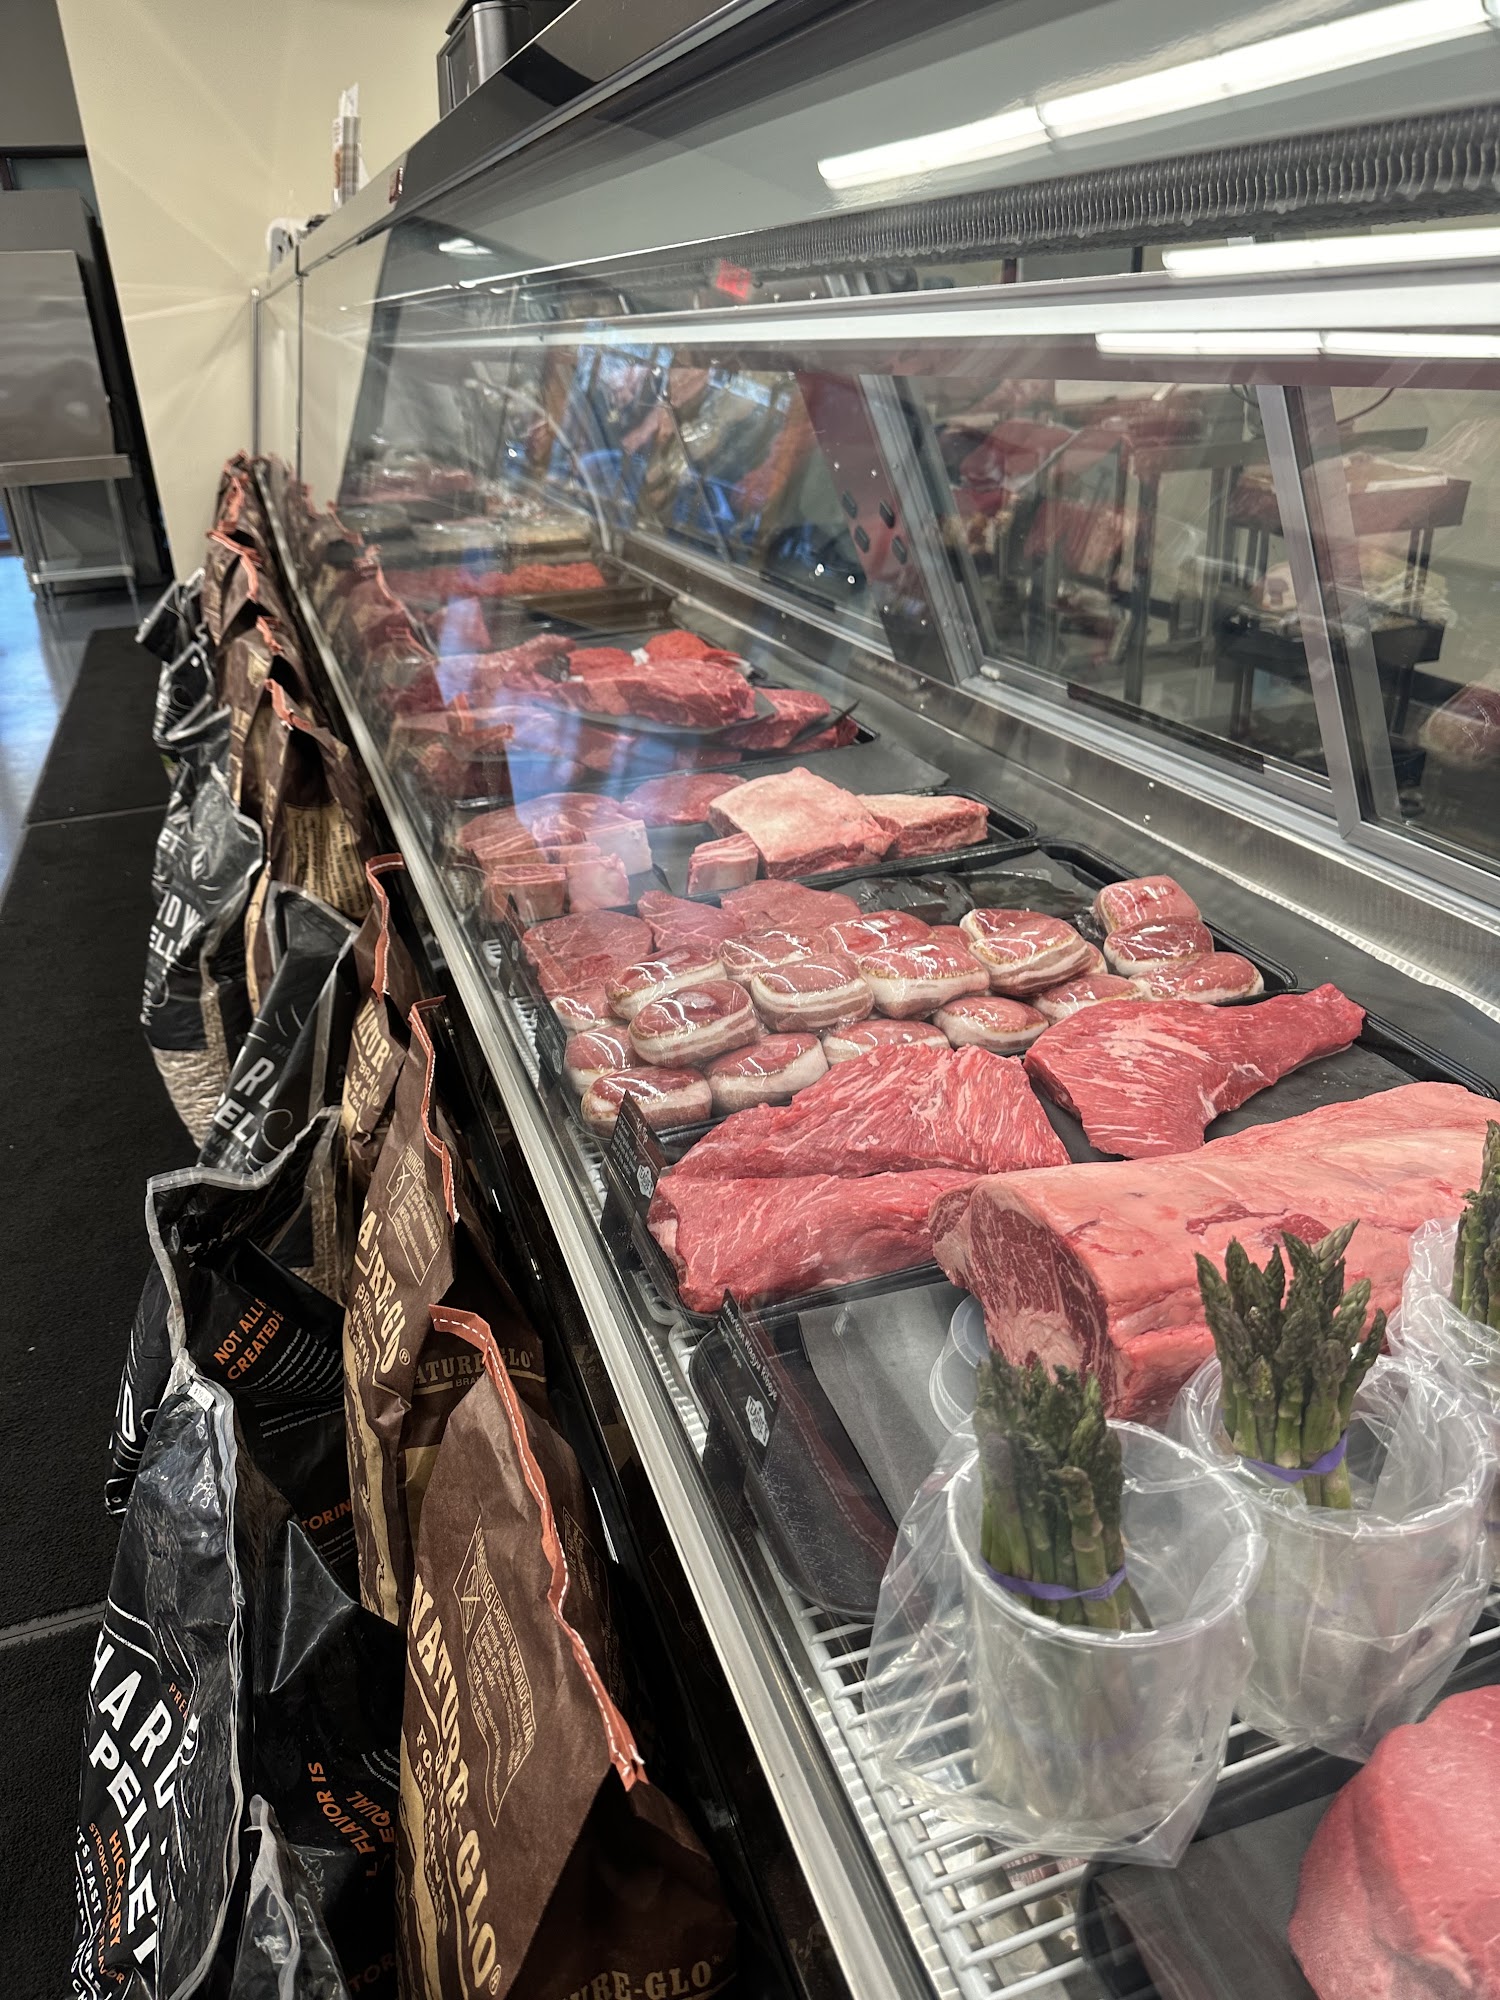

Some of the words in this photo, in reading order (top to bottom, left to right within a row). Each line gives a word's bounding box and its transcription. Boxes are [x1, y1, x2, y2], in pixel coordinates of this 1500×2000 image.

[356, 997, 393, 1072] NATUR
[358, 1060, 376, 1088] BRA
[213, 1329, 243, 1366] NOT
[238, 1305, 264, 1334] ALL
[226, 1317, 280, 1380] CREATED
[723, 1300, 747, 1353] American
[759, 1363, 779, 1401] Ribeye
[301, 1499, 353, 1530] TORIN
[487, 1613, 501, 1652] Burning
[483, 1666, 497, 1691] odor.
[492, 1600, 513, 1646] CARBON
[509, 1643, 531, 1711] MONOXIDE
[521, 1703, 535, 1751] HAZA
[307, 1761, 327, 1783] IS
[317, 1788, 377, 1856] FLAVOR
[346, 1790, 395, 1843] EQUAL
[88, 1822, 109, 1876] STRONG
[89, 1729, 158, 1964] PELLET
[85, 1860, 102, 1914] FAST
[108, 1829, 126, 1948] HICKORY
